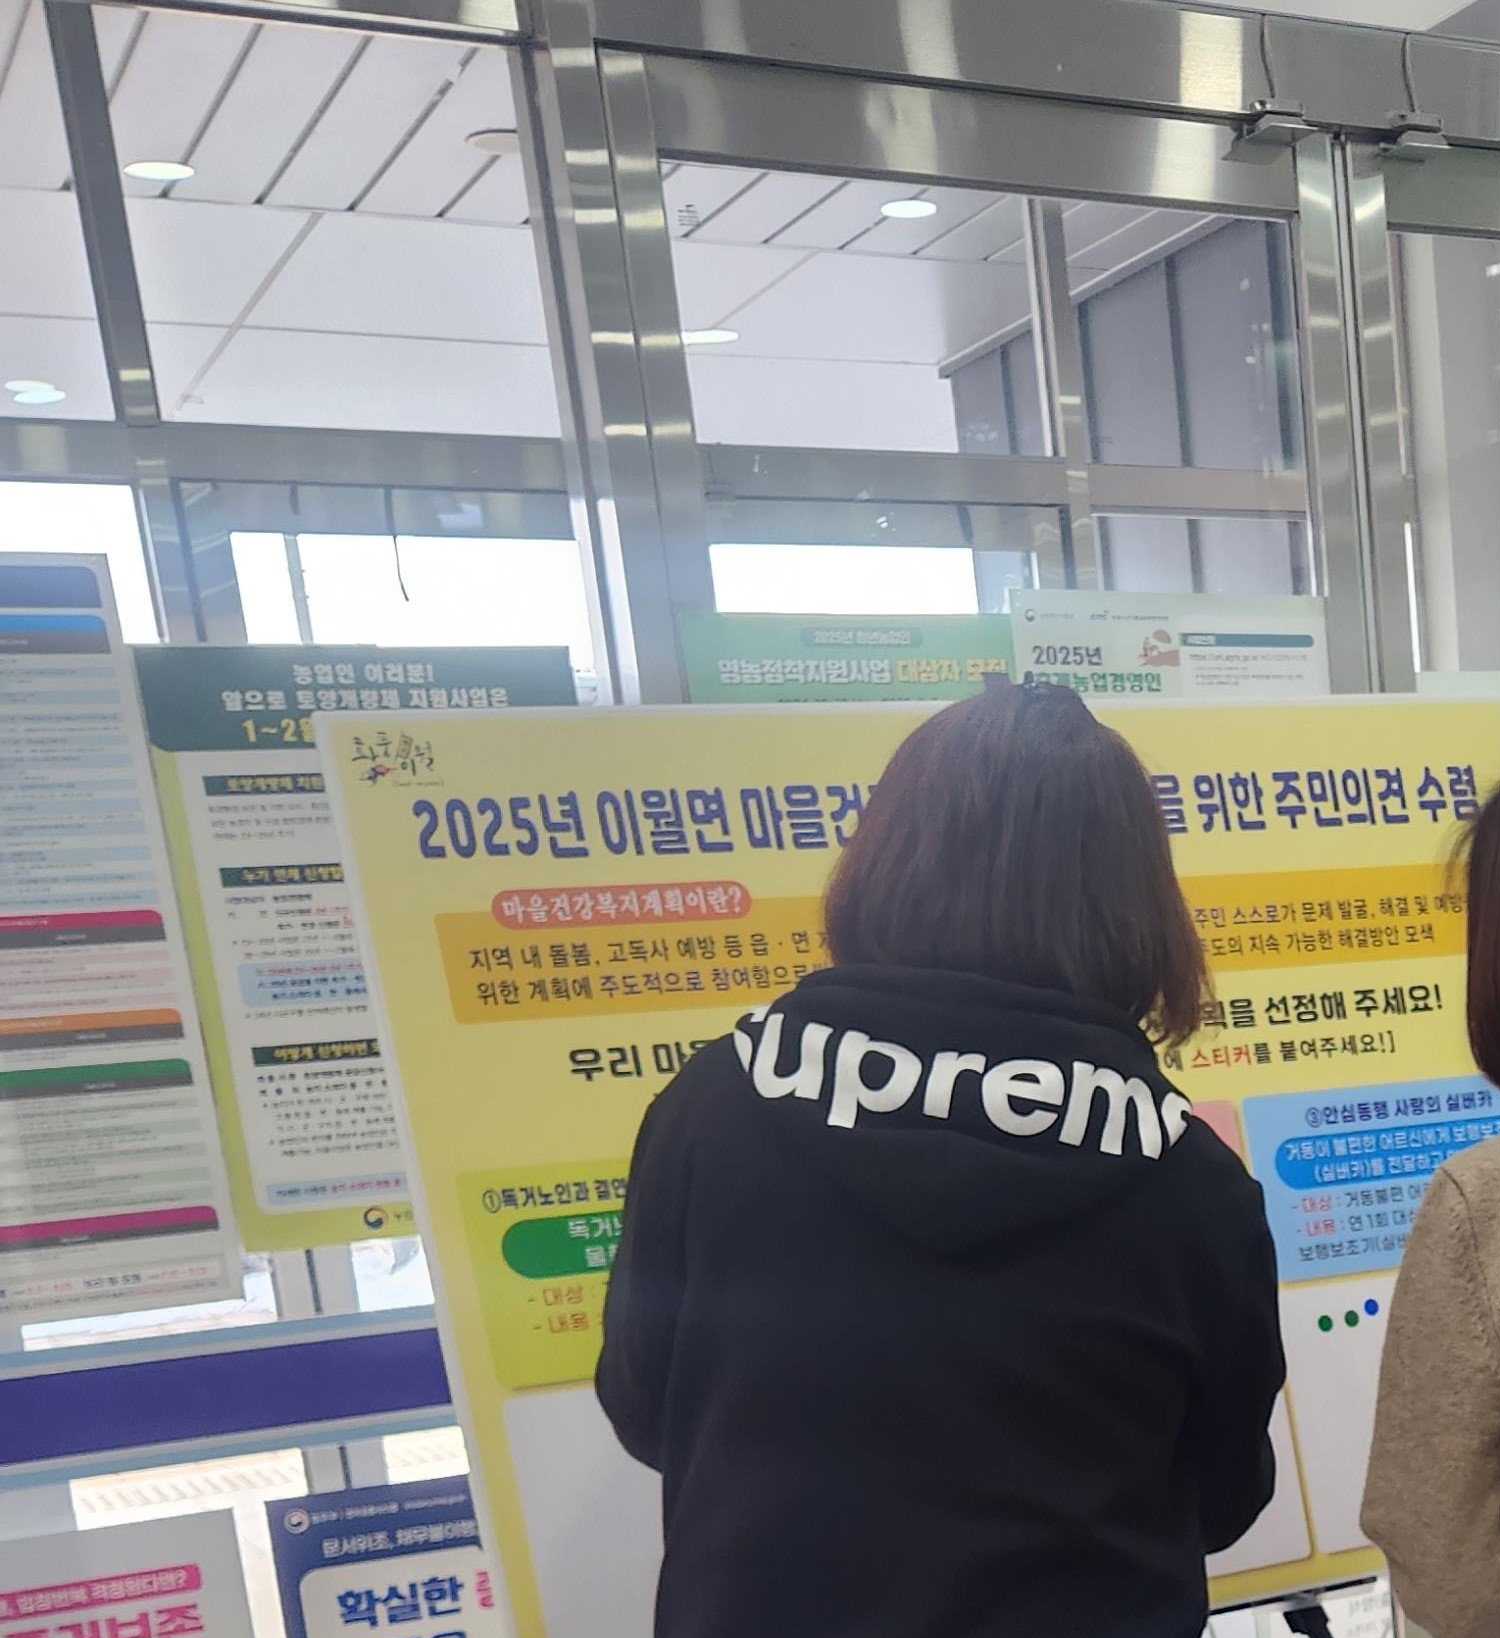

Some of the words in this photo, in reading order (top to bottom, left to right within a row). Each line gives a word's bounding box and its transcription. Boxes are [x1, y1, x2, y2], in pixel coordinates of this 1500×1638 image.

[1031, 645, 1103, 667] 2025년
[293, 662, 356, 686] 농업인
[364, 662, 435, 685] 여러분!
[896, 659, 962, 683] 대상자
[408, 686, 510, 710] 지원사업은
[412, 790, 590, 859] 2025년
[597, 788, 735, 856] 이월면
[740, 783, 878, 850] 마을건
[1193, 771, 1267, 833] 위한
[1272, 767, 1410, 829] 주민의견
[1417, 764, 1480, 823] 수렴
[500, 886, 742, 924] 마을건강복지계획이란?
[1194, 906, 1226, 929] 주민
[1232, 903, 1297, 925] 스스로가
[1301, 901, 1334, 922] 문제
[1379, 896, 1409, 918] 해결
[1414, 894, 1430, 915] 및
[470, 947, 513, 972] 지역
[520, 944, 543, 968] 내
[607, 938, 670, 964] 고독사
[676, 935, 718, 960] 예방
[723, 934, 744, 958] 등
[750, 932, 769, 956] 읍
[791, 929, 810, 954] 면
[1249, 932, 1282, 954] 지속
[1287, 929, 1334, 953] 가능한
[1338, 925, 1400, 949] 해결방안
[1405, 922, 1436, 944] 모색
[477, 981, 520, 1006] 위한
[529, 976, 594, 1003] 계획에
[600, 968, 704, 998] 주도적으로
[711, 963, 834, 992] 참여함으로
[568, 1044, 644, 1082] 우리
[1263, 990, 1348, 1027] 선정해
[1353, 983, 1444, 1019] 주세요!
[1190, 1042, 1272, 1069] 스티커를
[1394, 1095, 1443, 1118] 사랑의
[1446, 1090, 1493, 1113] 실버카
[1286, 1141, 1331, 1162] 거동이
[1302, 1194, 1333, 1213] 대상
[1344, 1186, 1404, 1208] 거동불편
[1306, 1218, 1337, 1237] 내용
[542, 1285, 585, 1307] 대상
[548, 1312, 590, 1334] 내용
[336, 1574, 464, 1628] 확실한
